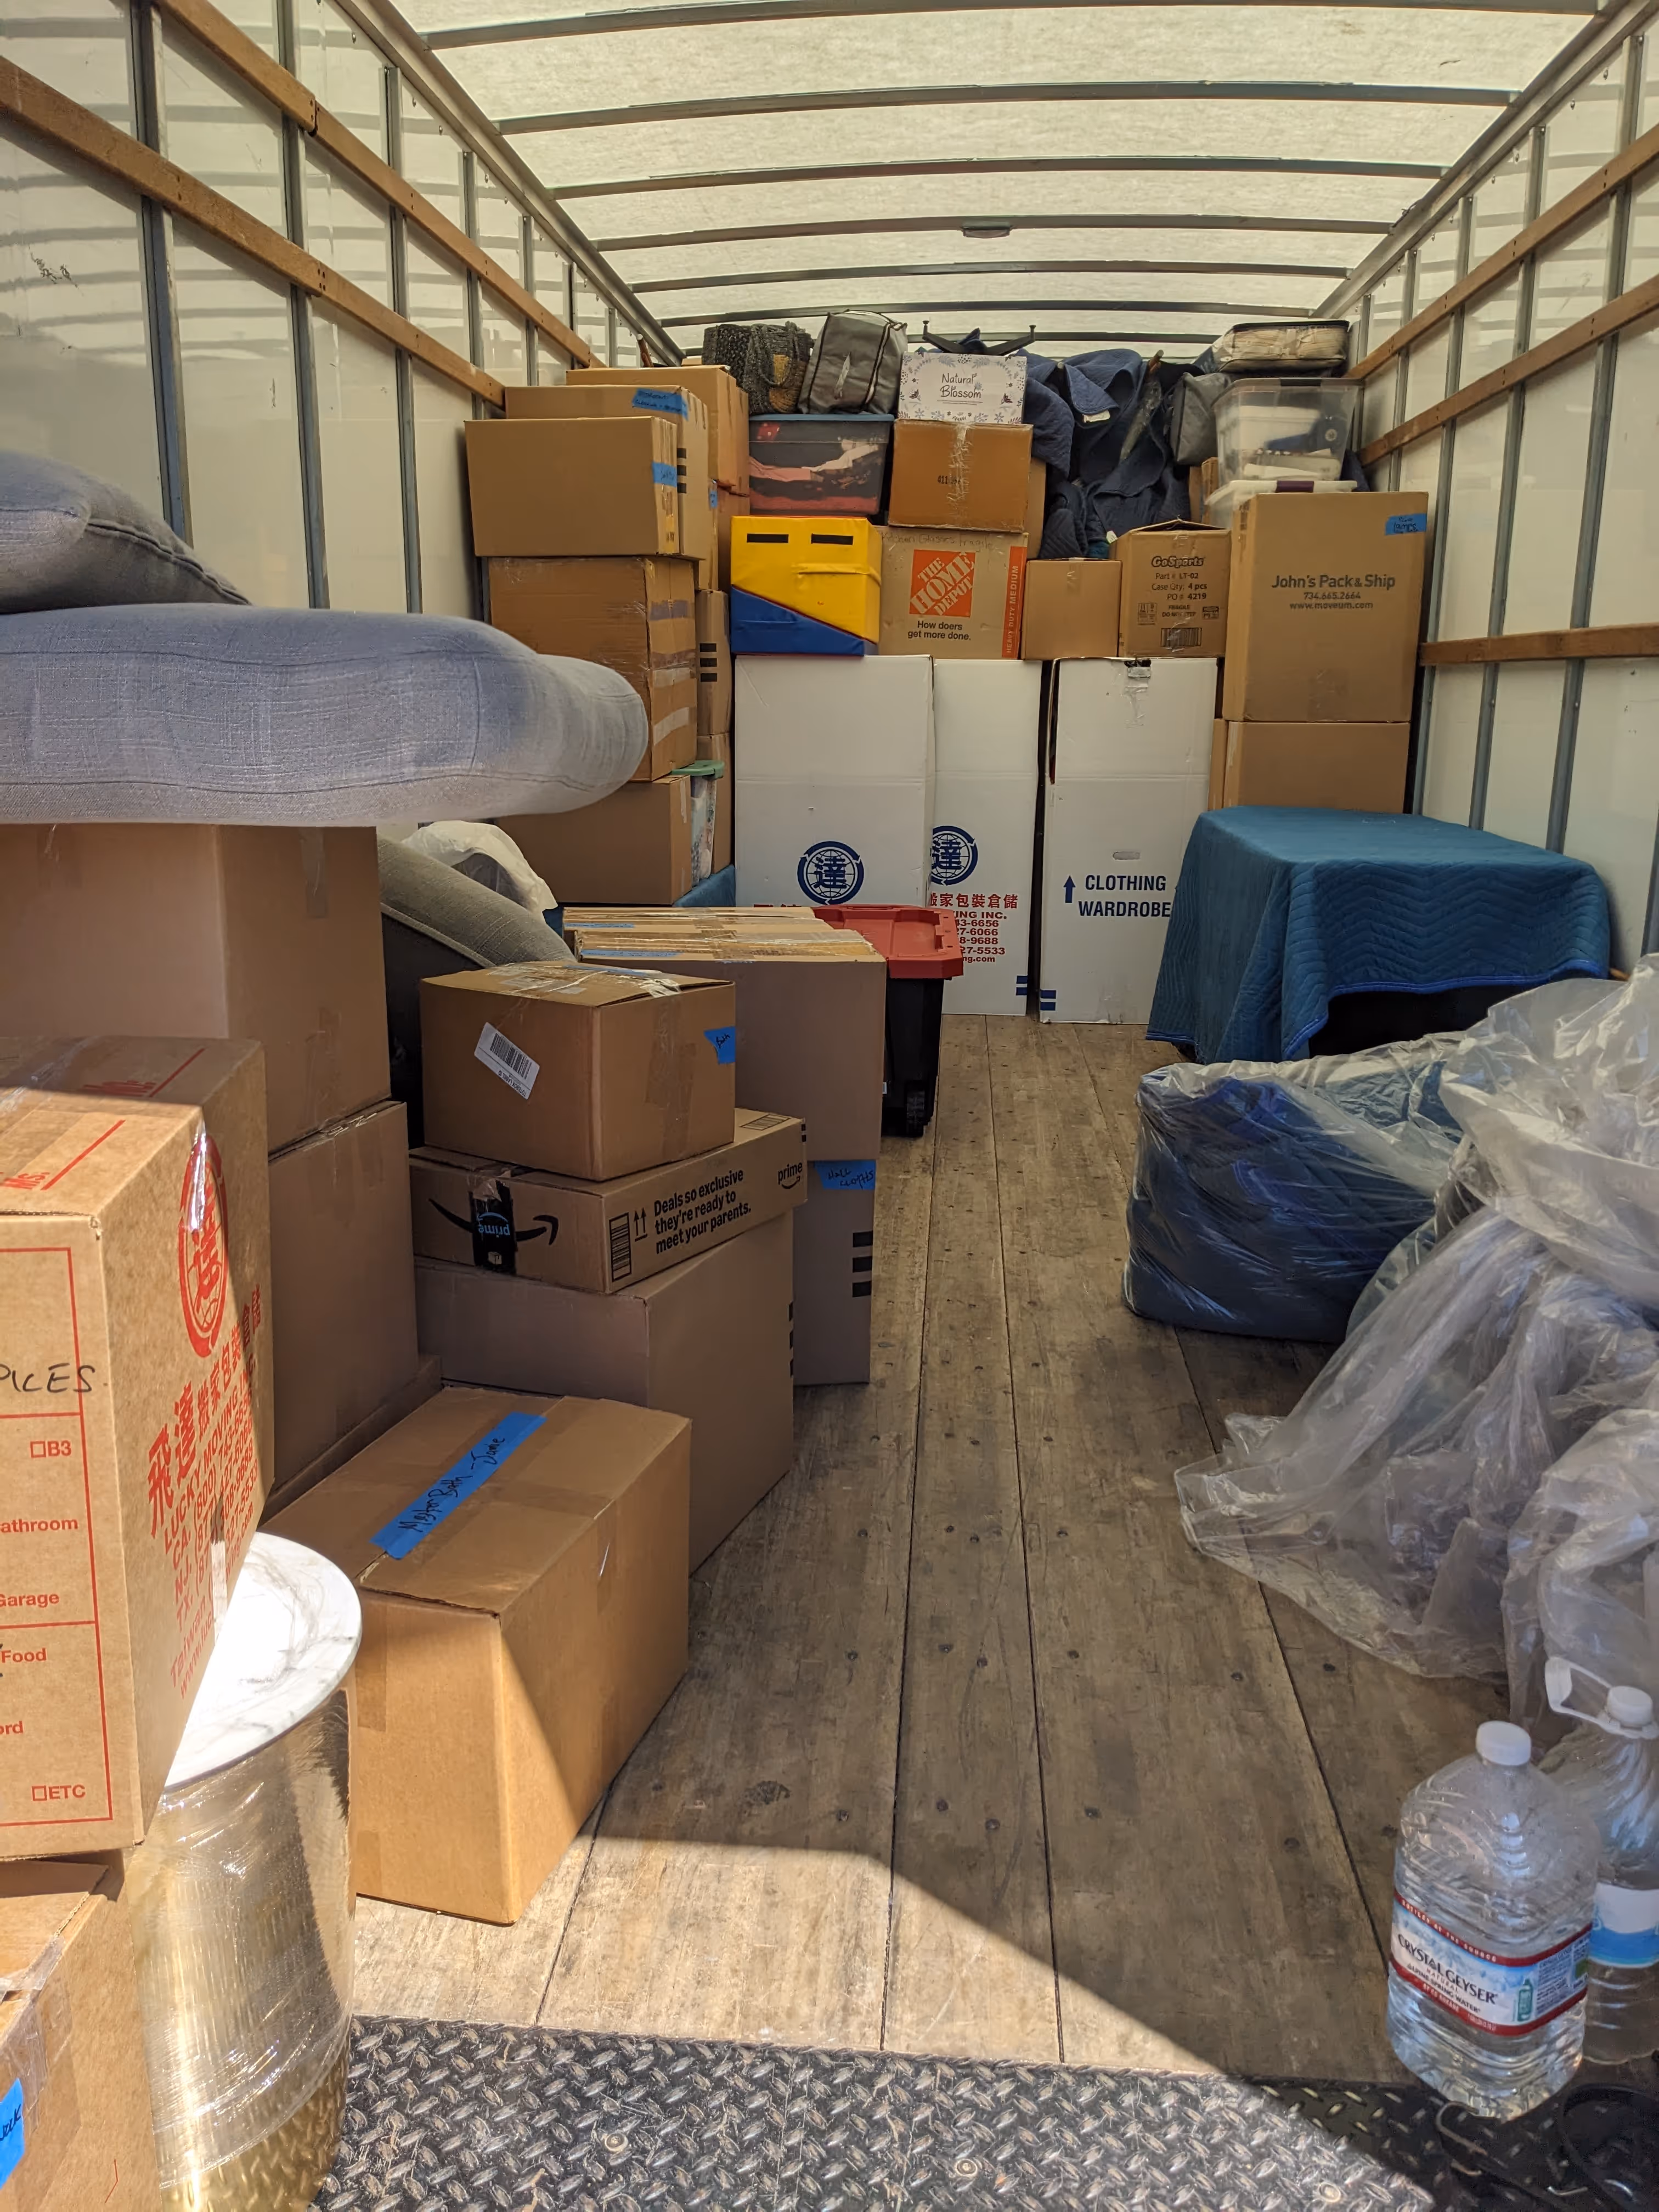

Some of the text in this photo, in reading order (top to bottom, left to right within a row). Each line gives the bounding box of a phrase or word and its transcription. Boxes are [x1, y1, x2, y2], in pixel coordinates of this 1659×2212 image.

[941, 373, 978, 384] Natural
[940, 385, 981, 399] Blossom
[917, 557, 945, 583] THE
[1152, 556, 1204, 568] GoSports
[910, 552, 975, 614] HOME
[1009, 566, 1019, 603] MEDIUM
[1170, 583, 1184, 591] Qty:
[1272, 575, 1316, 588] John's
[1319, 575, 1353, 588] Pack
[1364, 574, 1396, 590] Ship
[934, 576, 973, 616] DEPOT
[1304, 591, 1361, 600] 734.665.2664
[908, 630, 922, 639] get
[948, 632, 971, 640] done.
[917, 620, 963, 630] How doers
[1085, 874, 1166, 891] CLOTHING
[1079, 901, 1171, 917] WARDROBE
[778, 1162, 803, 1185] prime
[654, 1169, 744, 1217] Deals so exclusive
[654, 1190, 736, 1235] they're ready to
[478, 1224, 510, 1238] prime
[656, 1203, 752, 1255] meet your parents.
[48, 1440, 71, 1457] B3
[164, 1352, 256, 1555] LUCKY MOVING INC.
[173, 1380, 252, 1571] CA. (800) 743-6656
[174, 1413, 252, 1604] NJ. (877) 427-6066
[0, 1519, 78, 1533] athroom
[171, 1457, 258, 1688] Taiwan 327-5533
[176, 1591, 193, 1633] TX.
[1, 1647, 47, 1663] Food
[48, 1784, 86, 1800] ETC
[1446, 1929, 1459, 1945] THE
[1464, 1943, 1497, 1962] SOURCE
[1398, 1933, 1446, 1975] CRYSTAL
[1445, 1970, 1496, 2005] GEYSER
[1407, 1962, 1429, 1983] ALPINE
[1430, 1978, 1455, 1999] SPRING
[1426, 1968, 1459, 1992] NATURAL
